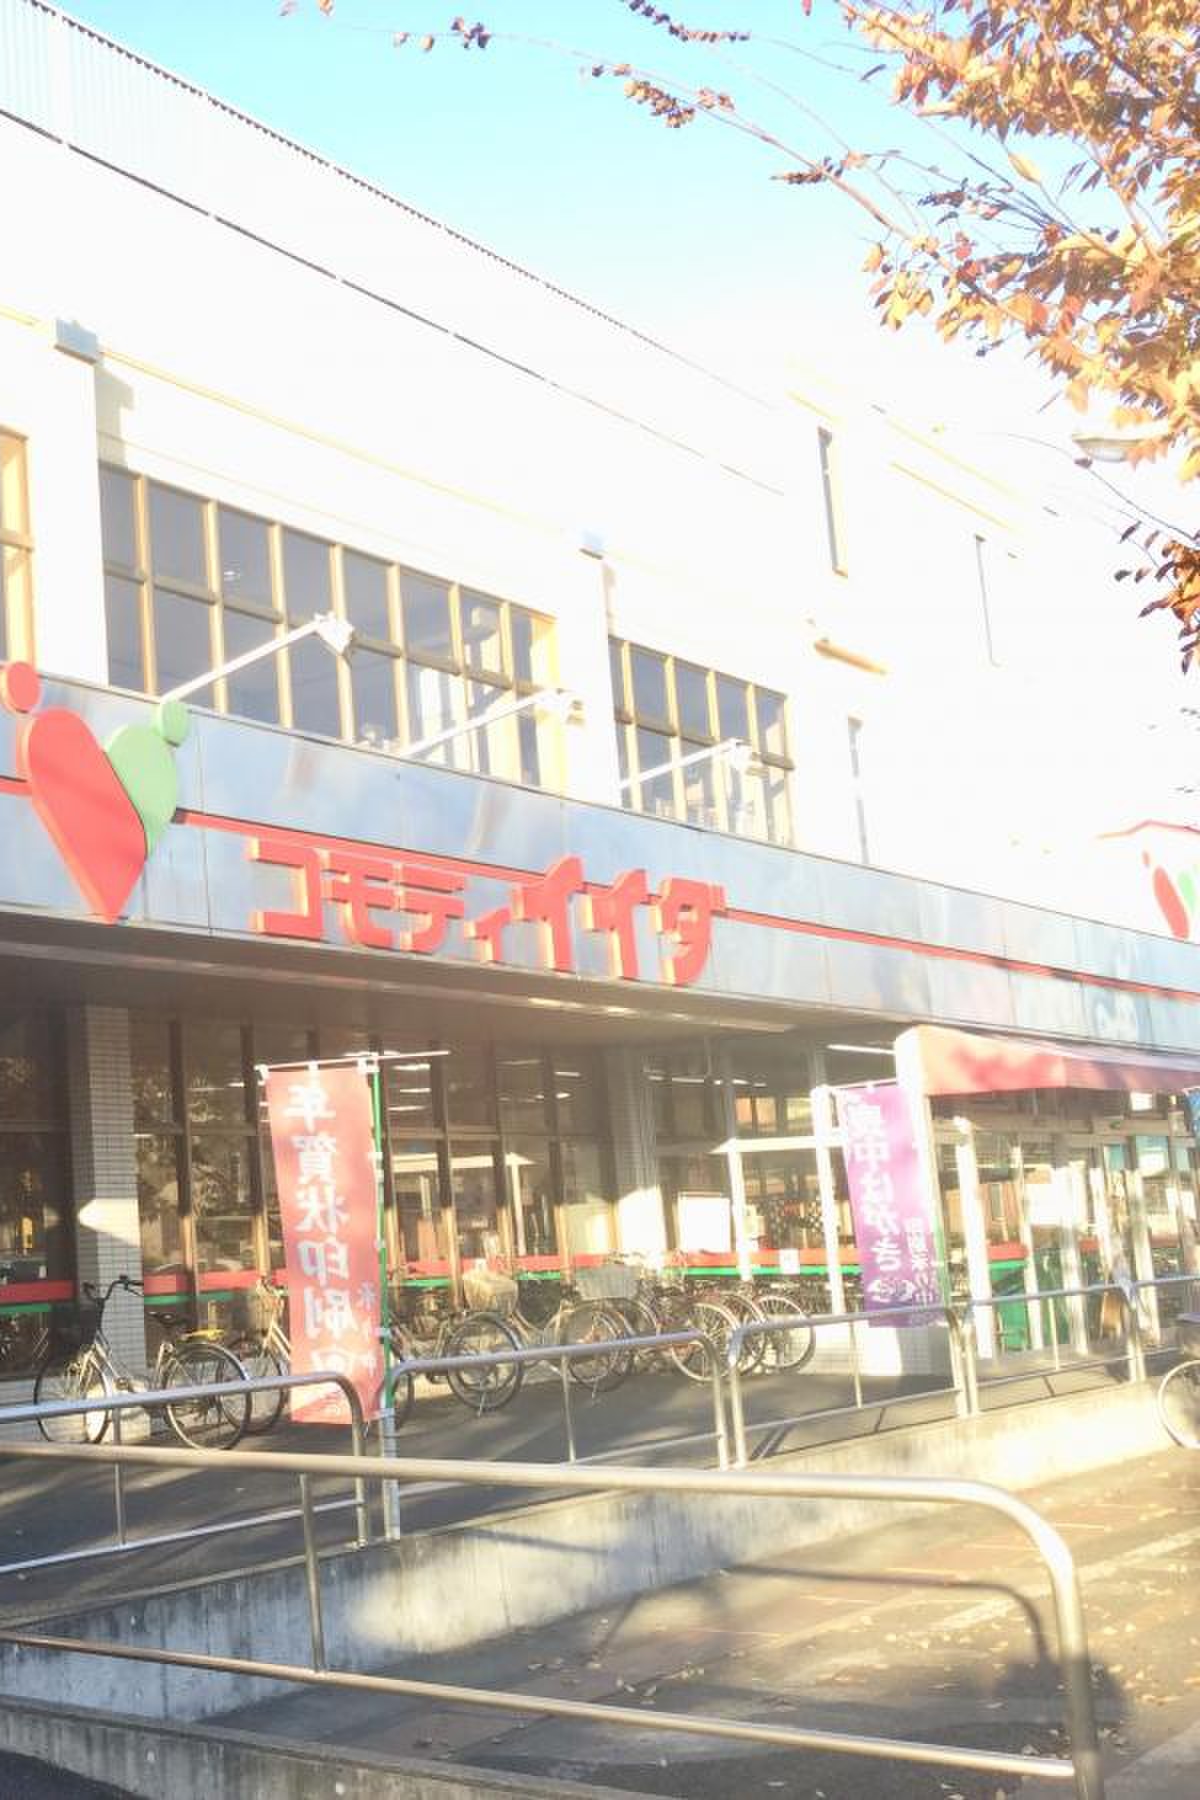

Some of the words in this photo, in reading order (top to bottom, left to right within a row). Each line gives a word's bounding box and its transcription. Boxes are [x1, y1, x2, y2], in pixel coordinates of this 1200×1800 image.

[246, 836, 725, 988] コモディイイダ
